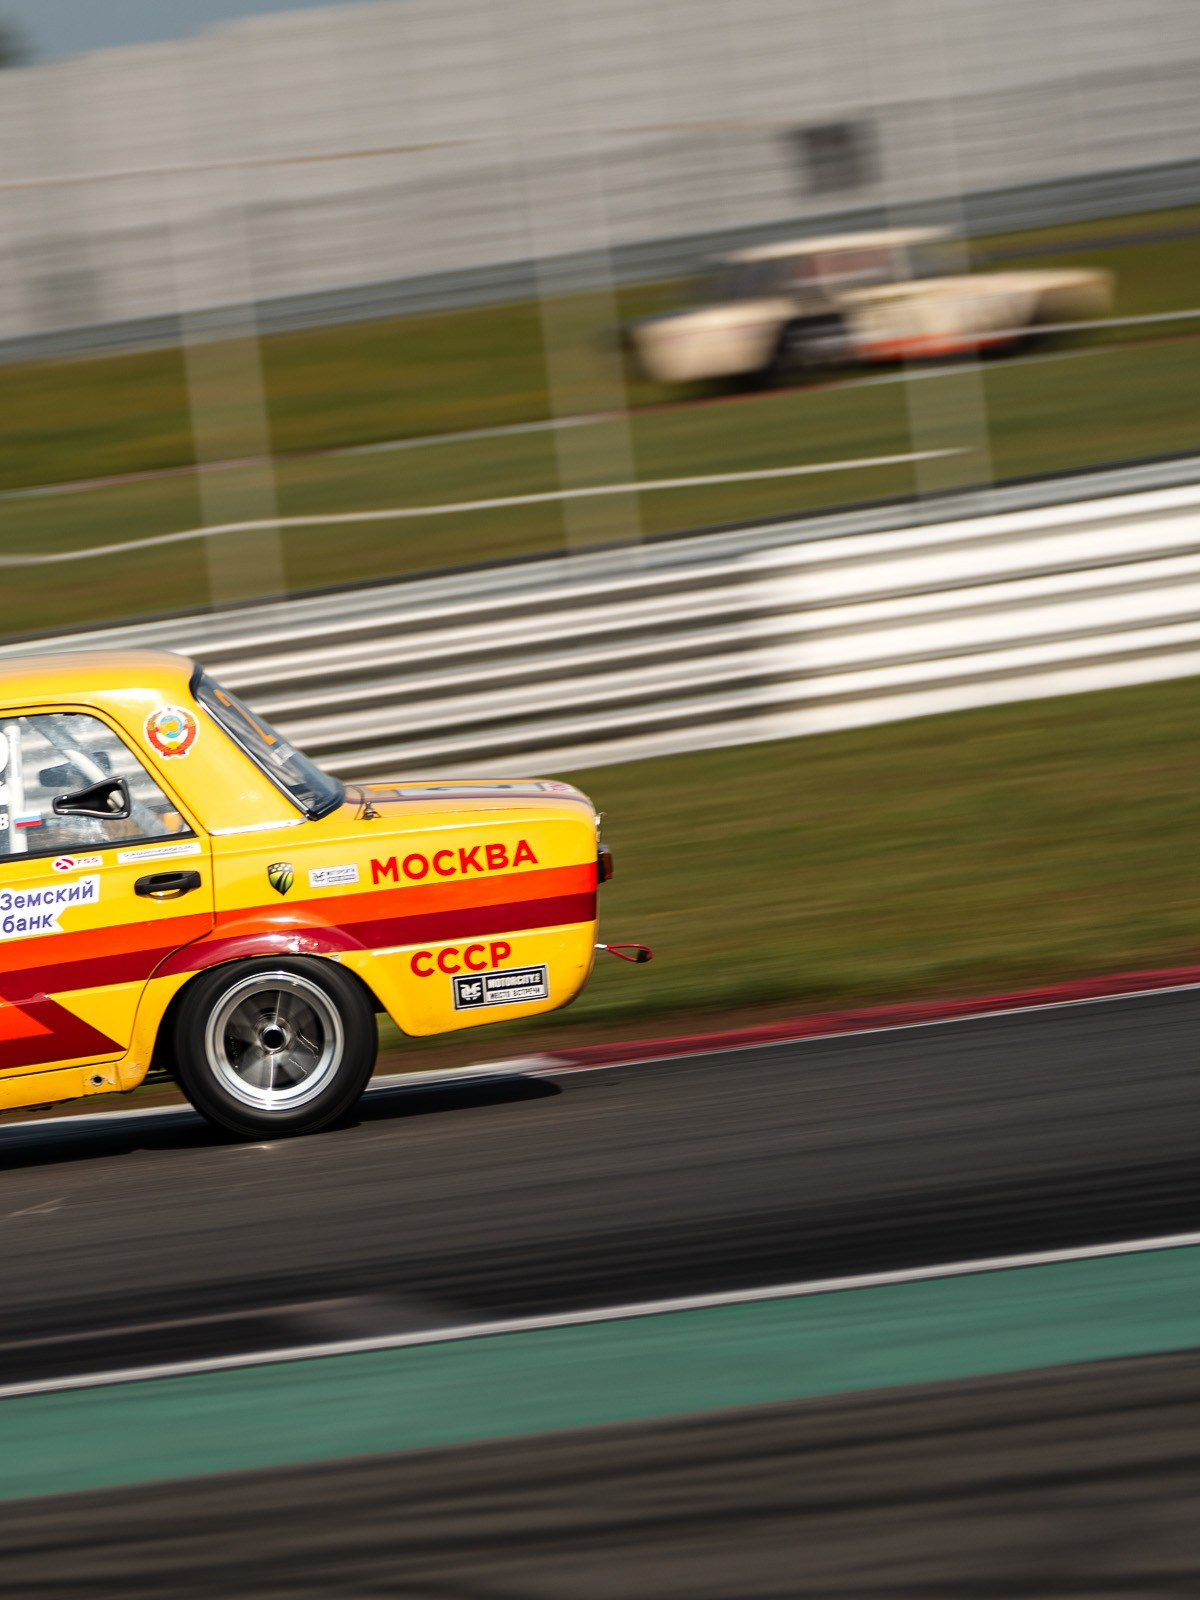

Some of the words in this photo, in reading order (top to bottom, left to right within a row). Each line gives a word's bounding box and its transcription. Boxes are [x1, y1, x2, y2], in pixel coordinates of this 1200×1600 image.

[370, 839, 539, 884] МОСКВА
[0, 880, 94, 911] Земский
[2, 914, 54, 933] банк
[411, 942, 511, 977] СССР
